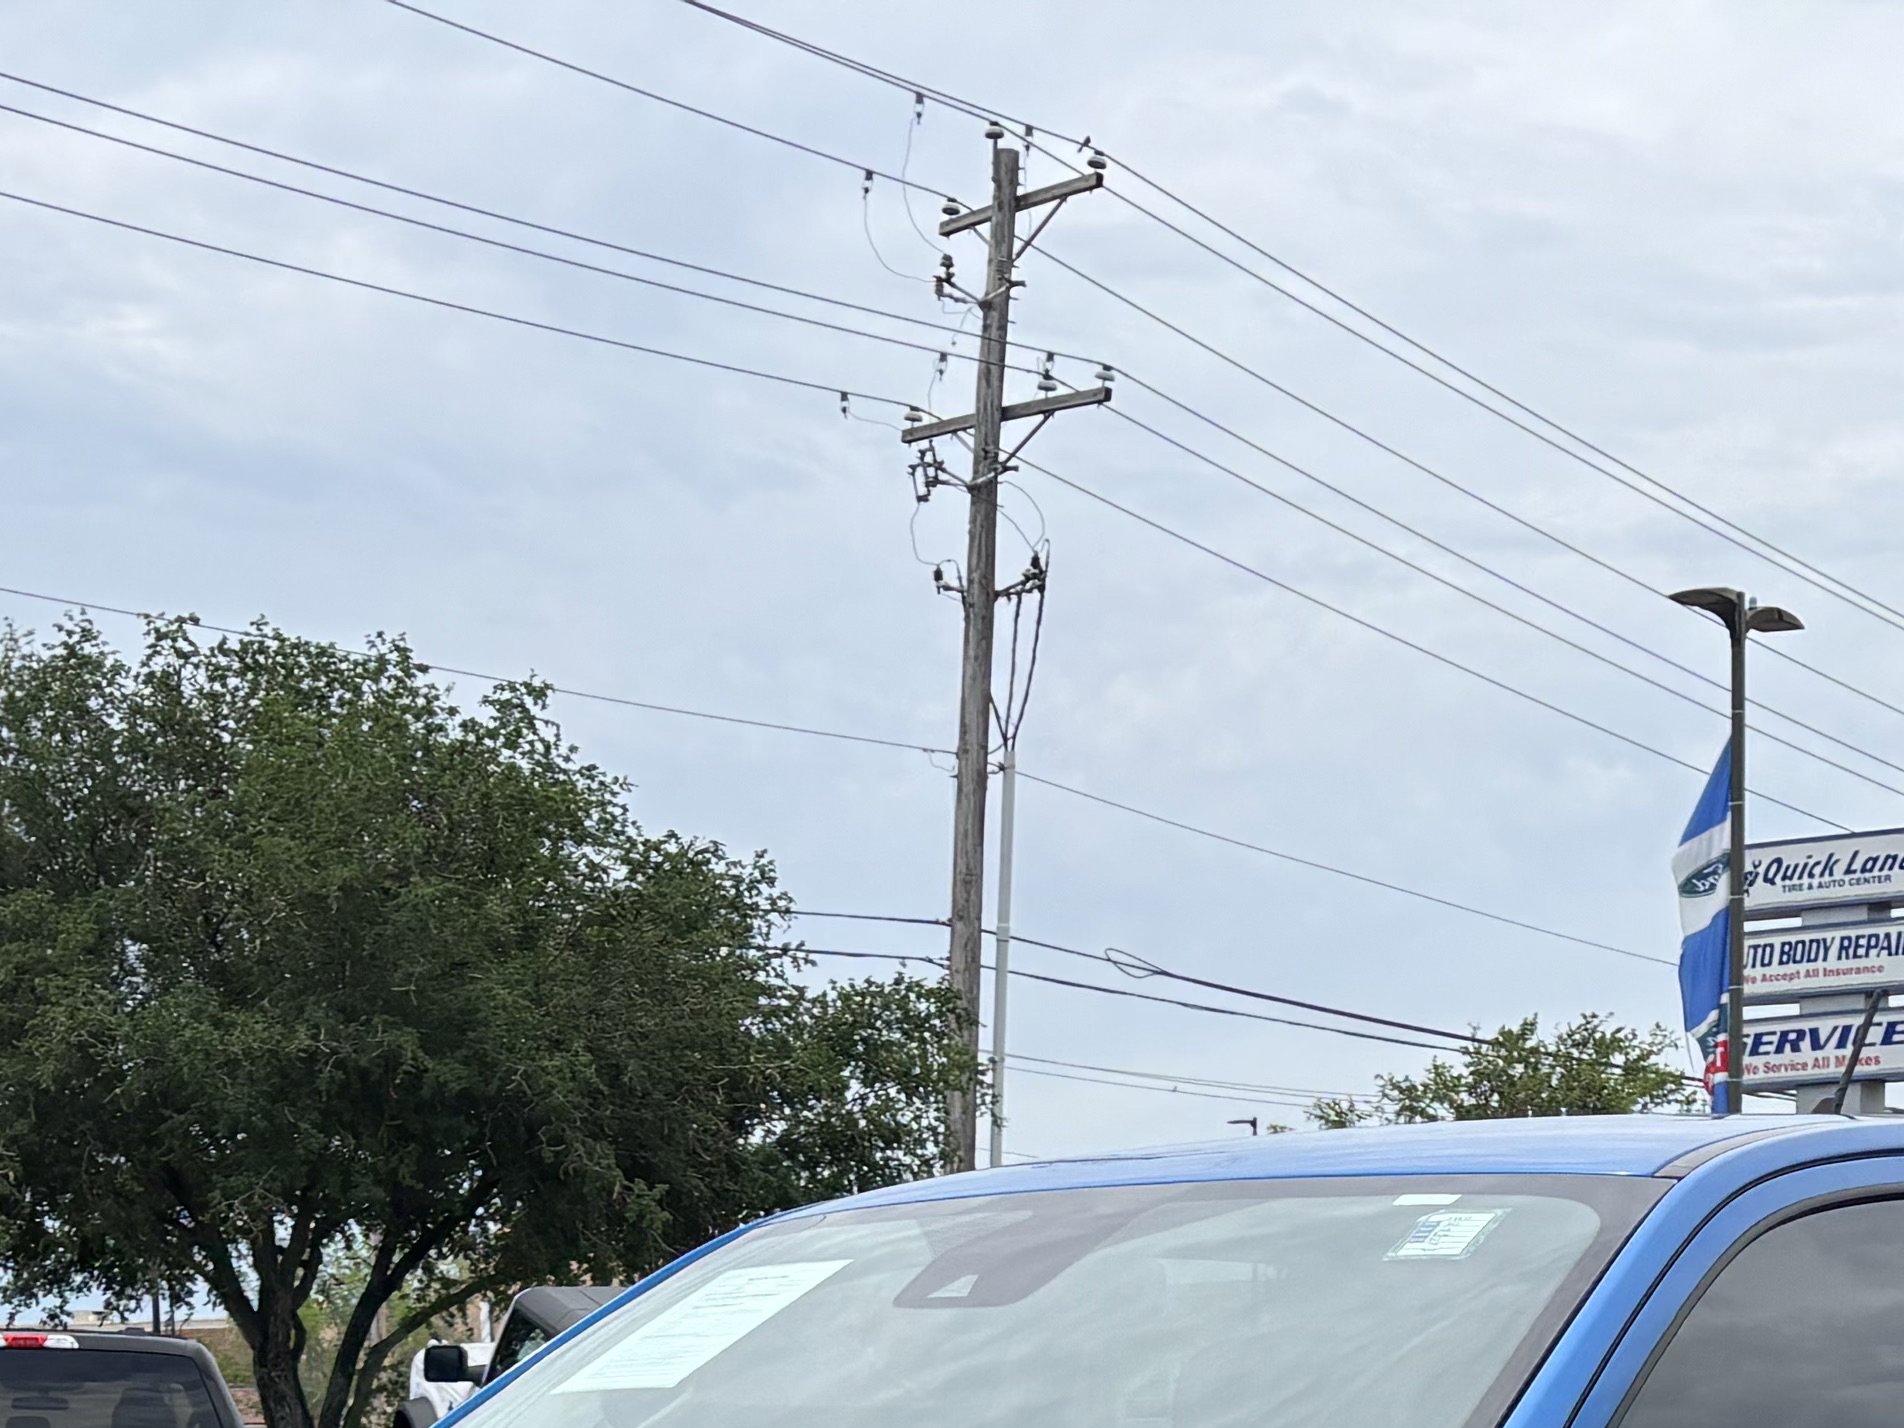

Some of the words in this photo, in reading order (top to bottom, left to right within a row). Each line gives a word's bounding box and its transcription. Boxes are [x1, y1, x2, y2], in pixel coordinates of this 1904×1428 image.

[1763, 852, 1841, 886] Quick
[1782, 882, 1805, 893] TIRE
[1817, 878, 1846, 889] AUTO
[1848, 874, 1892, 887] CENTER
[1778, 937, 1836, 966] BODY
[1823, 965, 1885, 978] Insurance
[1763, 1060, 1809, 1074] Service
[1811, 1056, 1830, 1070] All
